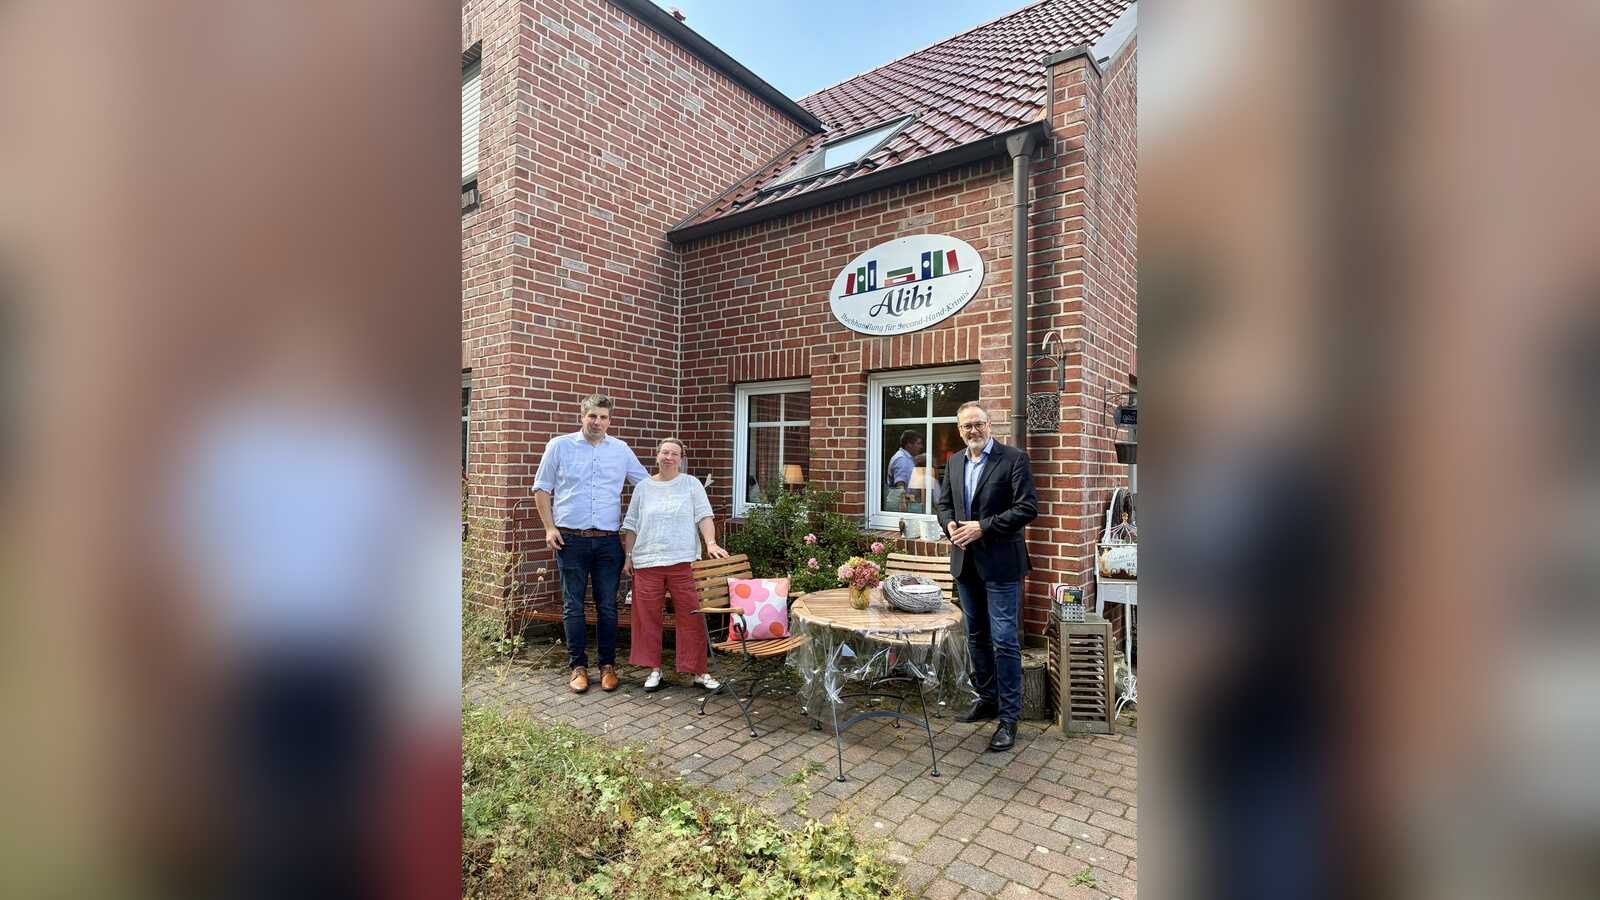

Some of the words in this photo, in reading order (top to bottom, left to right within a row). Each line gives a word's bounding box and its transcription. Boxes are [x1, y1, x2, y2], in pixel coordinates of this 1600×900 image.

[869, 285, 933, 317] Alibi
[841, 312, 884, 333] Buchhandlung
[884, 323, 897, 333] für
